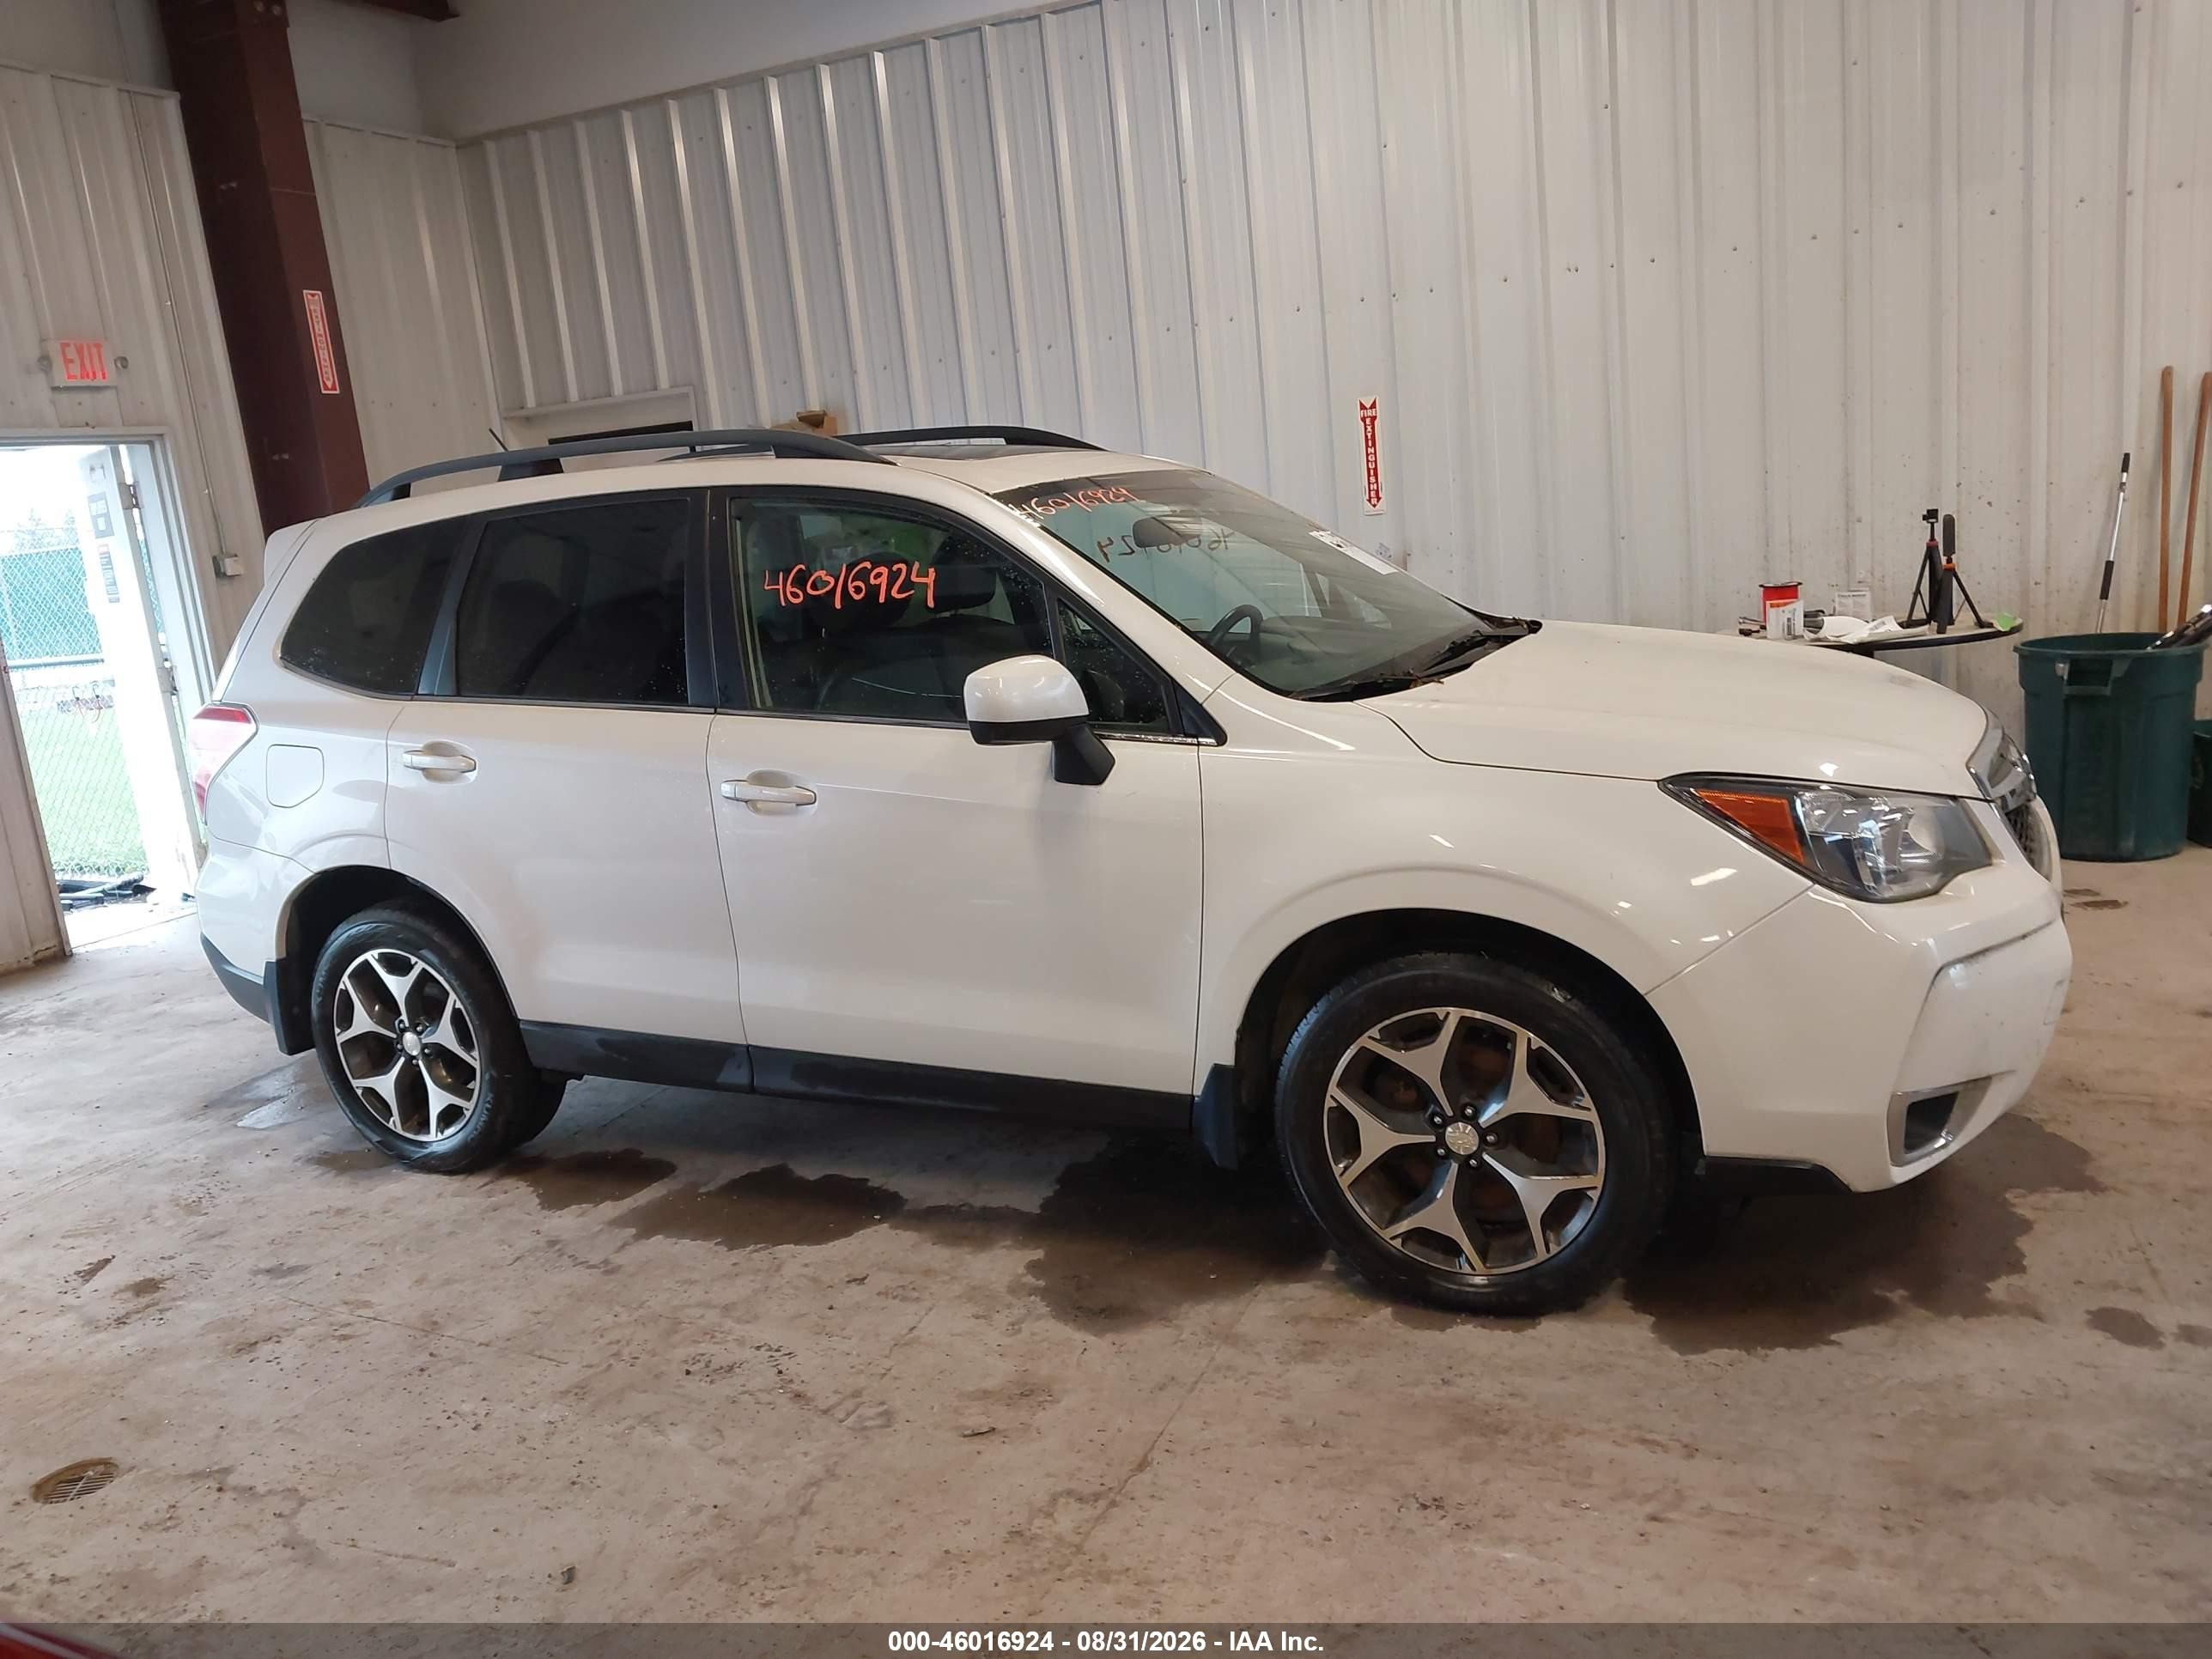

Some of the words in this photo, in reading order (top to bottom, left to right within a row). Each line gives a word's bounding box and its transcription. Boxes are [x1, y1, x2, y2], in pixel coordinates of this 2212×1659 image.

[59, 343, 106, 380] EXIT
[1360, 409, 1377, 417] FIRE
[1365, 418, 1378, 505] EXTINGUISHER
[763, 561, 936, 609] 46016924
